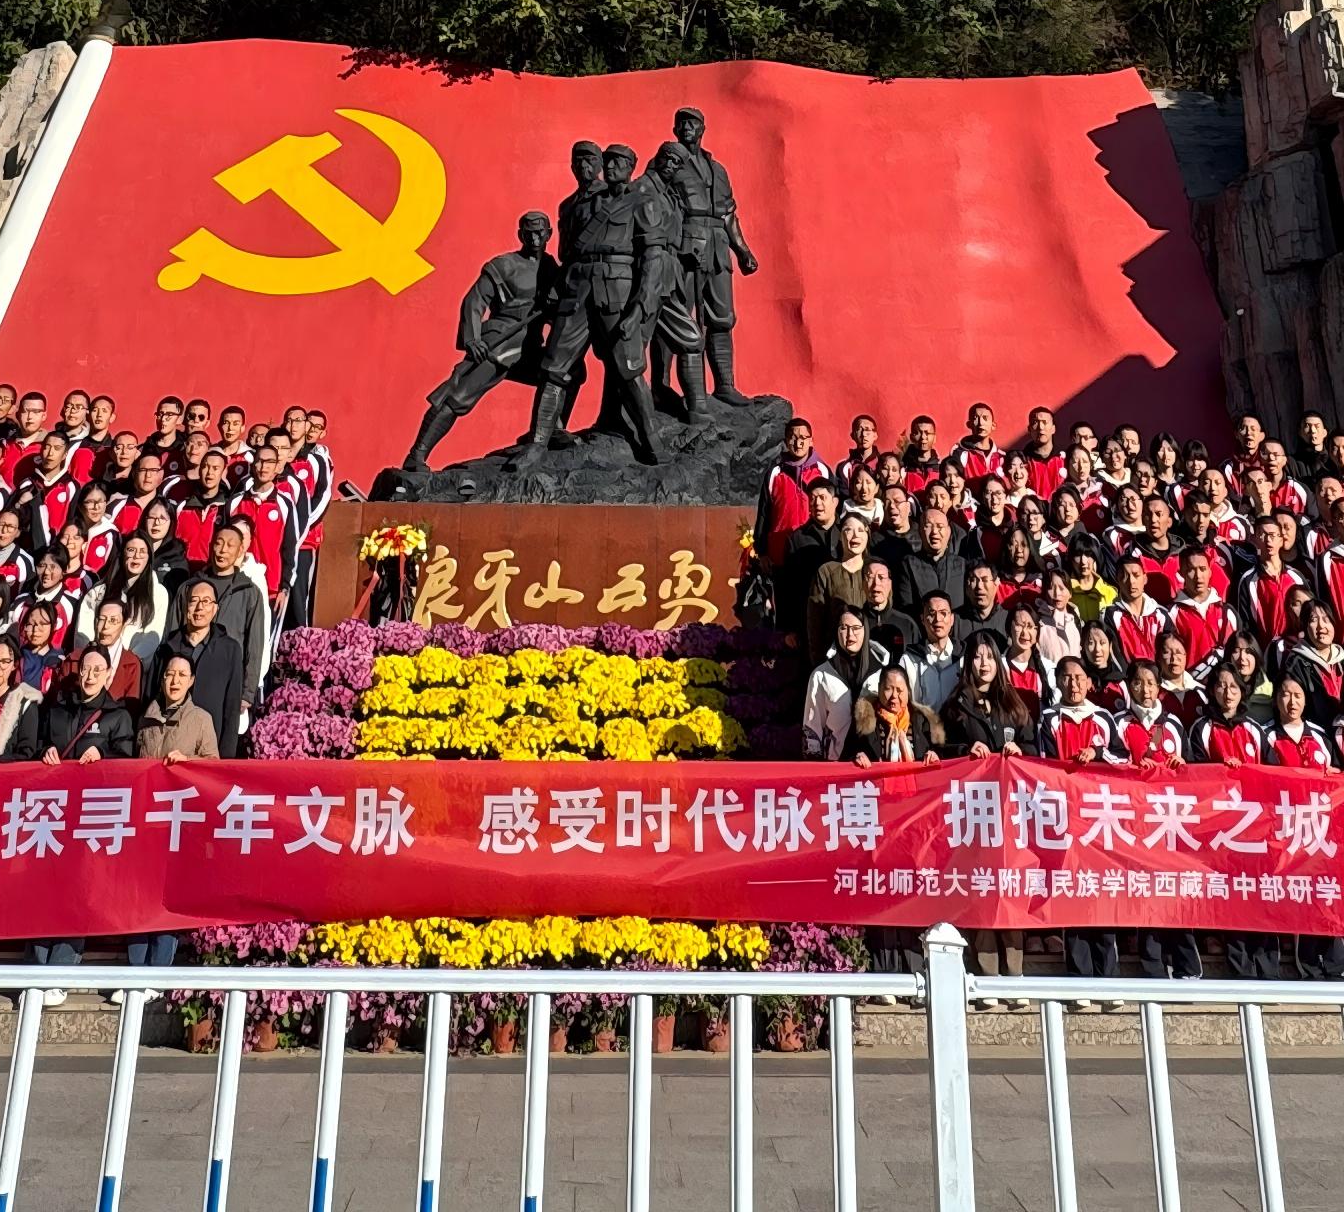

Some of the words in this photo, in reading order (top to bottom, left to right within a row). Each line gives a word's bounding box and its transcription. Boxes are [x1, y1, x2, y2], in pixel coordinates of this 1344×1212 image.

[1, 784, 415, 859] 探寻千年文脉
[478, 781, 884, 854] 感受时代脉搏
[942, 779, 1338, 857] 拥抱未来之城
